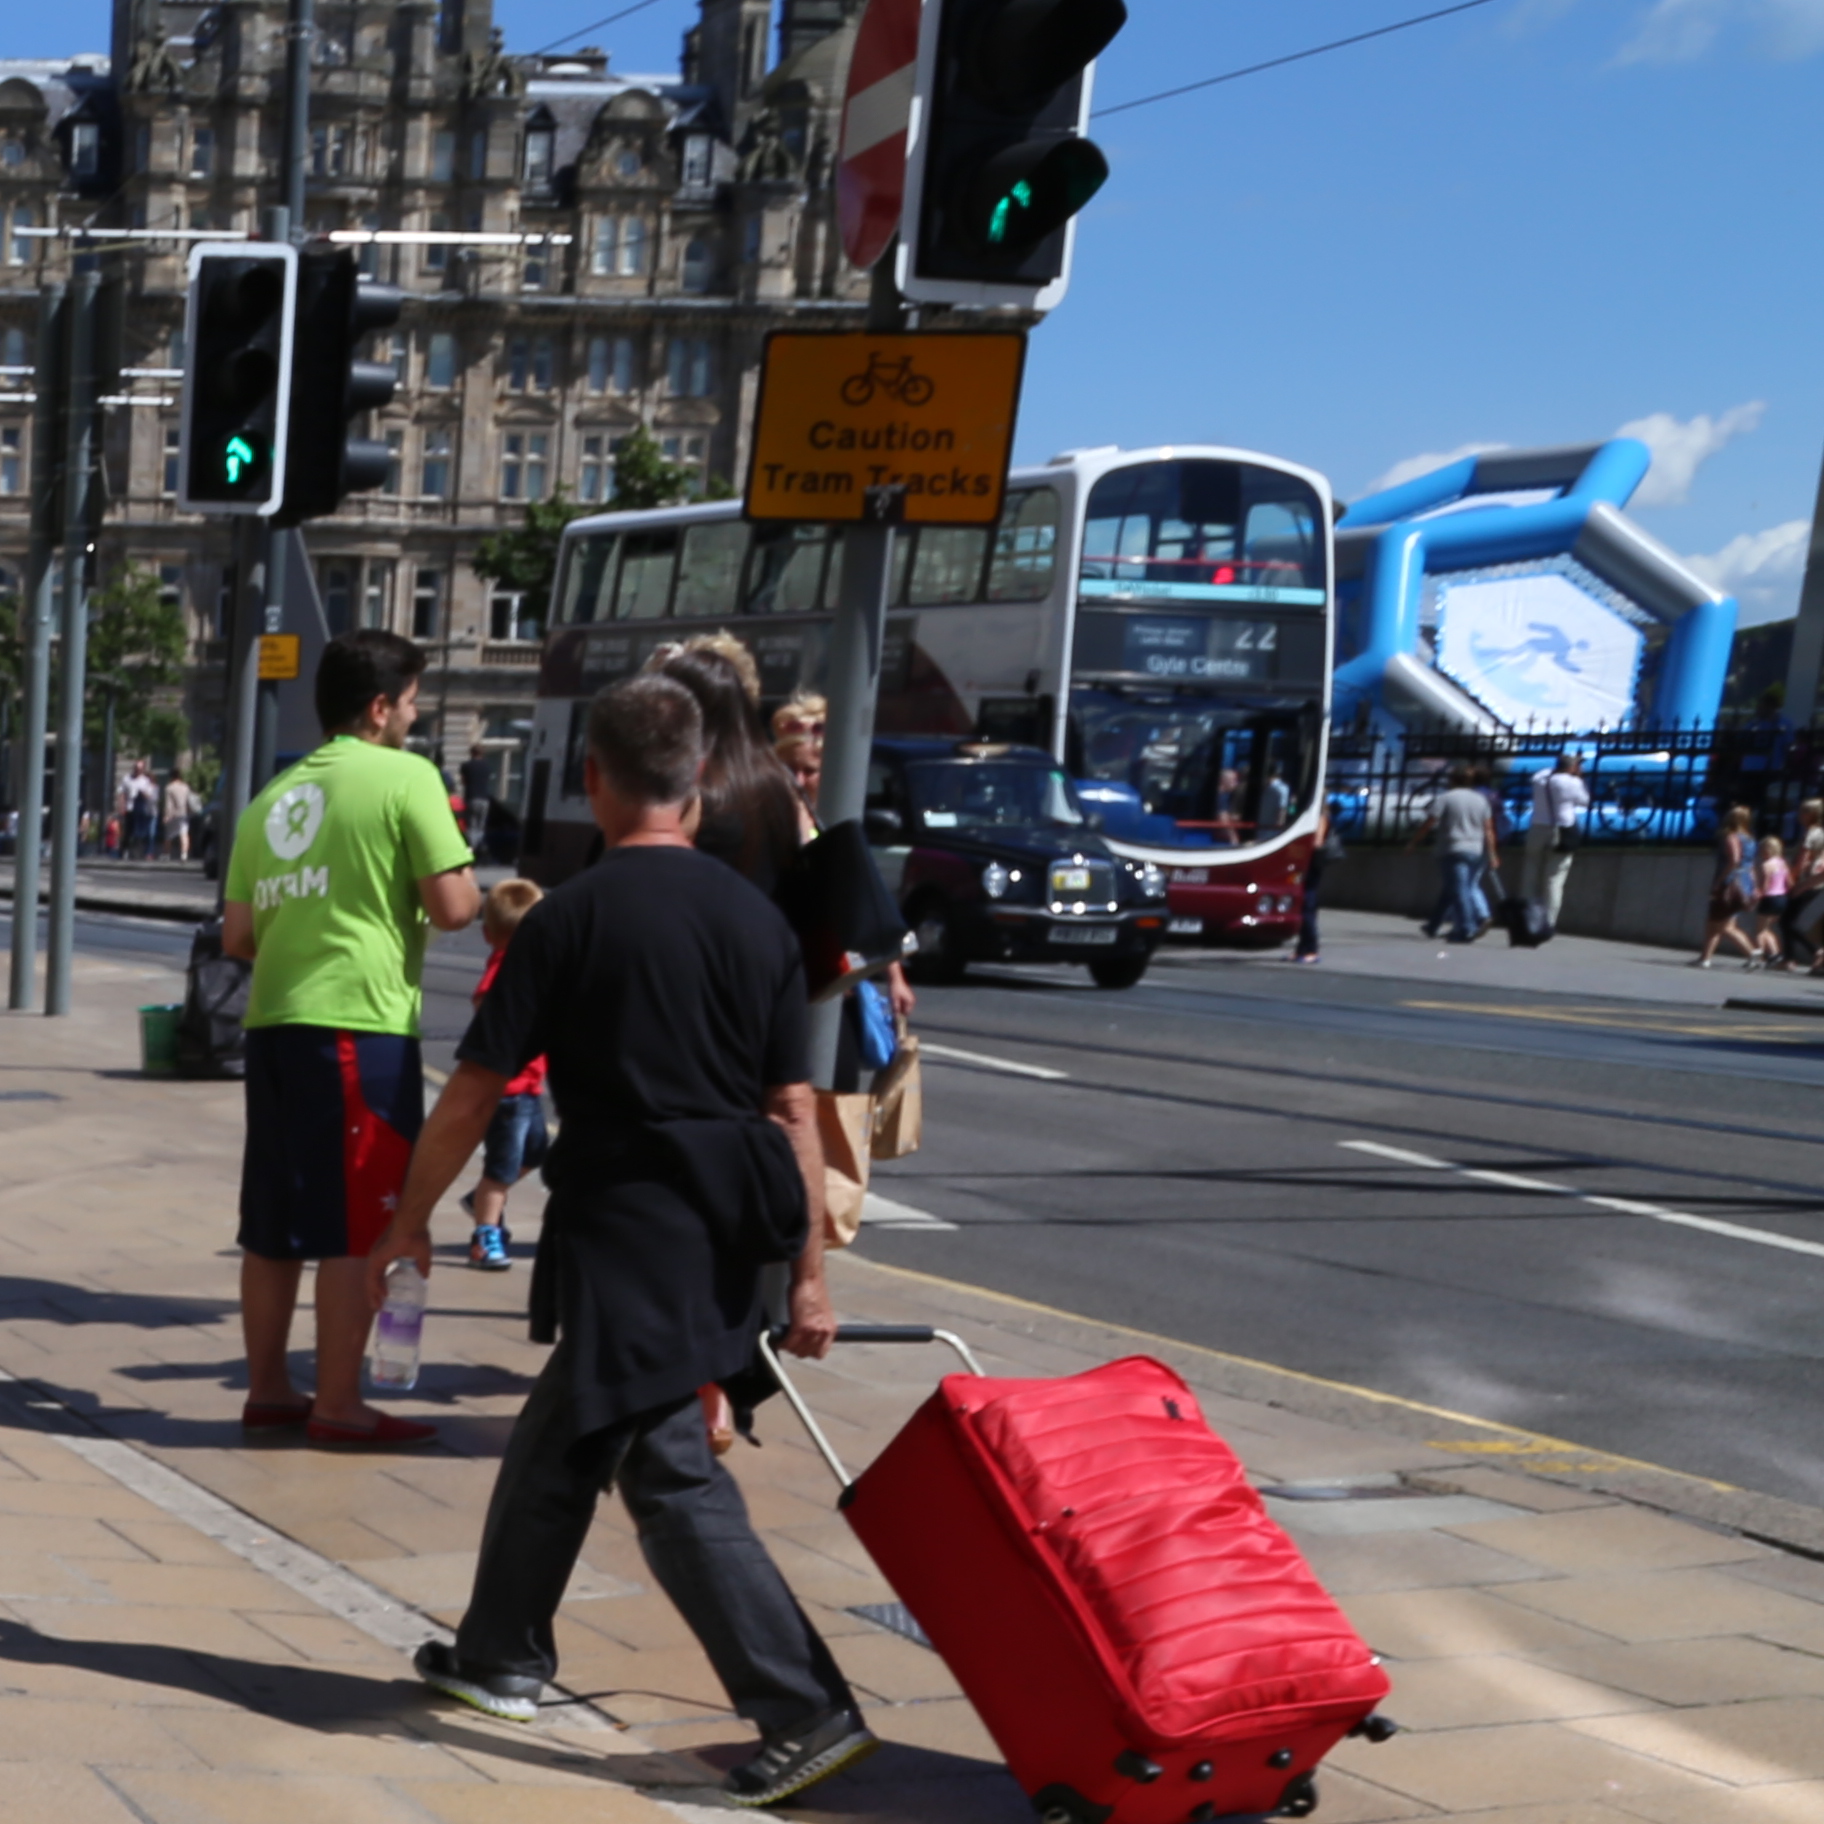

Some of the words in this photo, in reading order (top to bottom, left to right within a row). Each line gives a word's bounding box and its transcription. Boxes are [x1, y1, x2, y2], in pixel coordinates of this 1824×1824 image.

[809, 420, 955, 450] Caution
[763, 463, 853, 493] Tram
[867, 464, 992, 497] Tracks
[1235, 622, 1278, 650] 22
